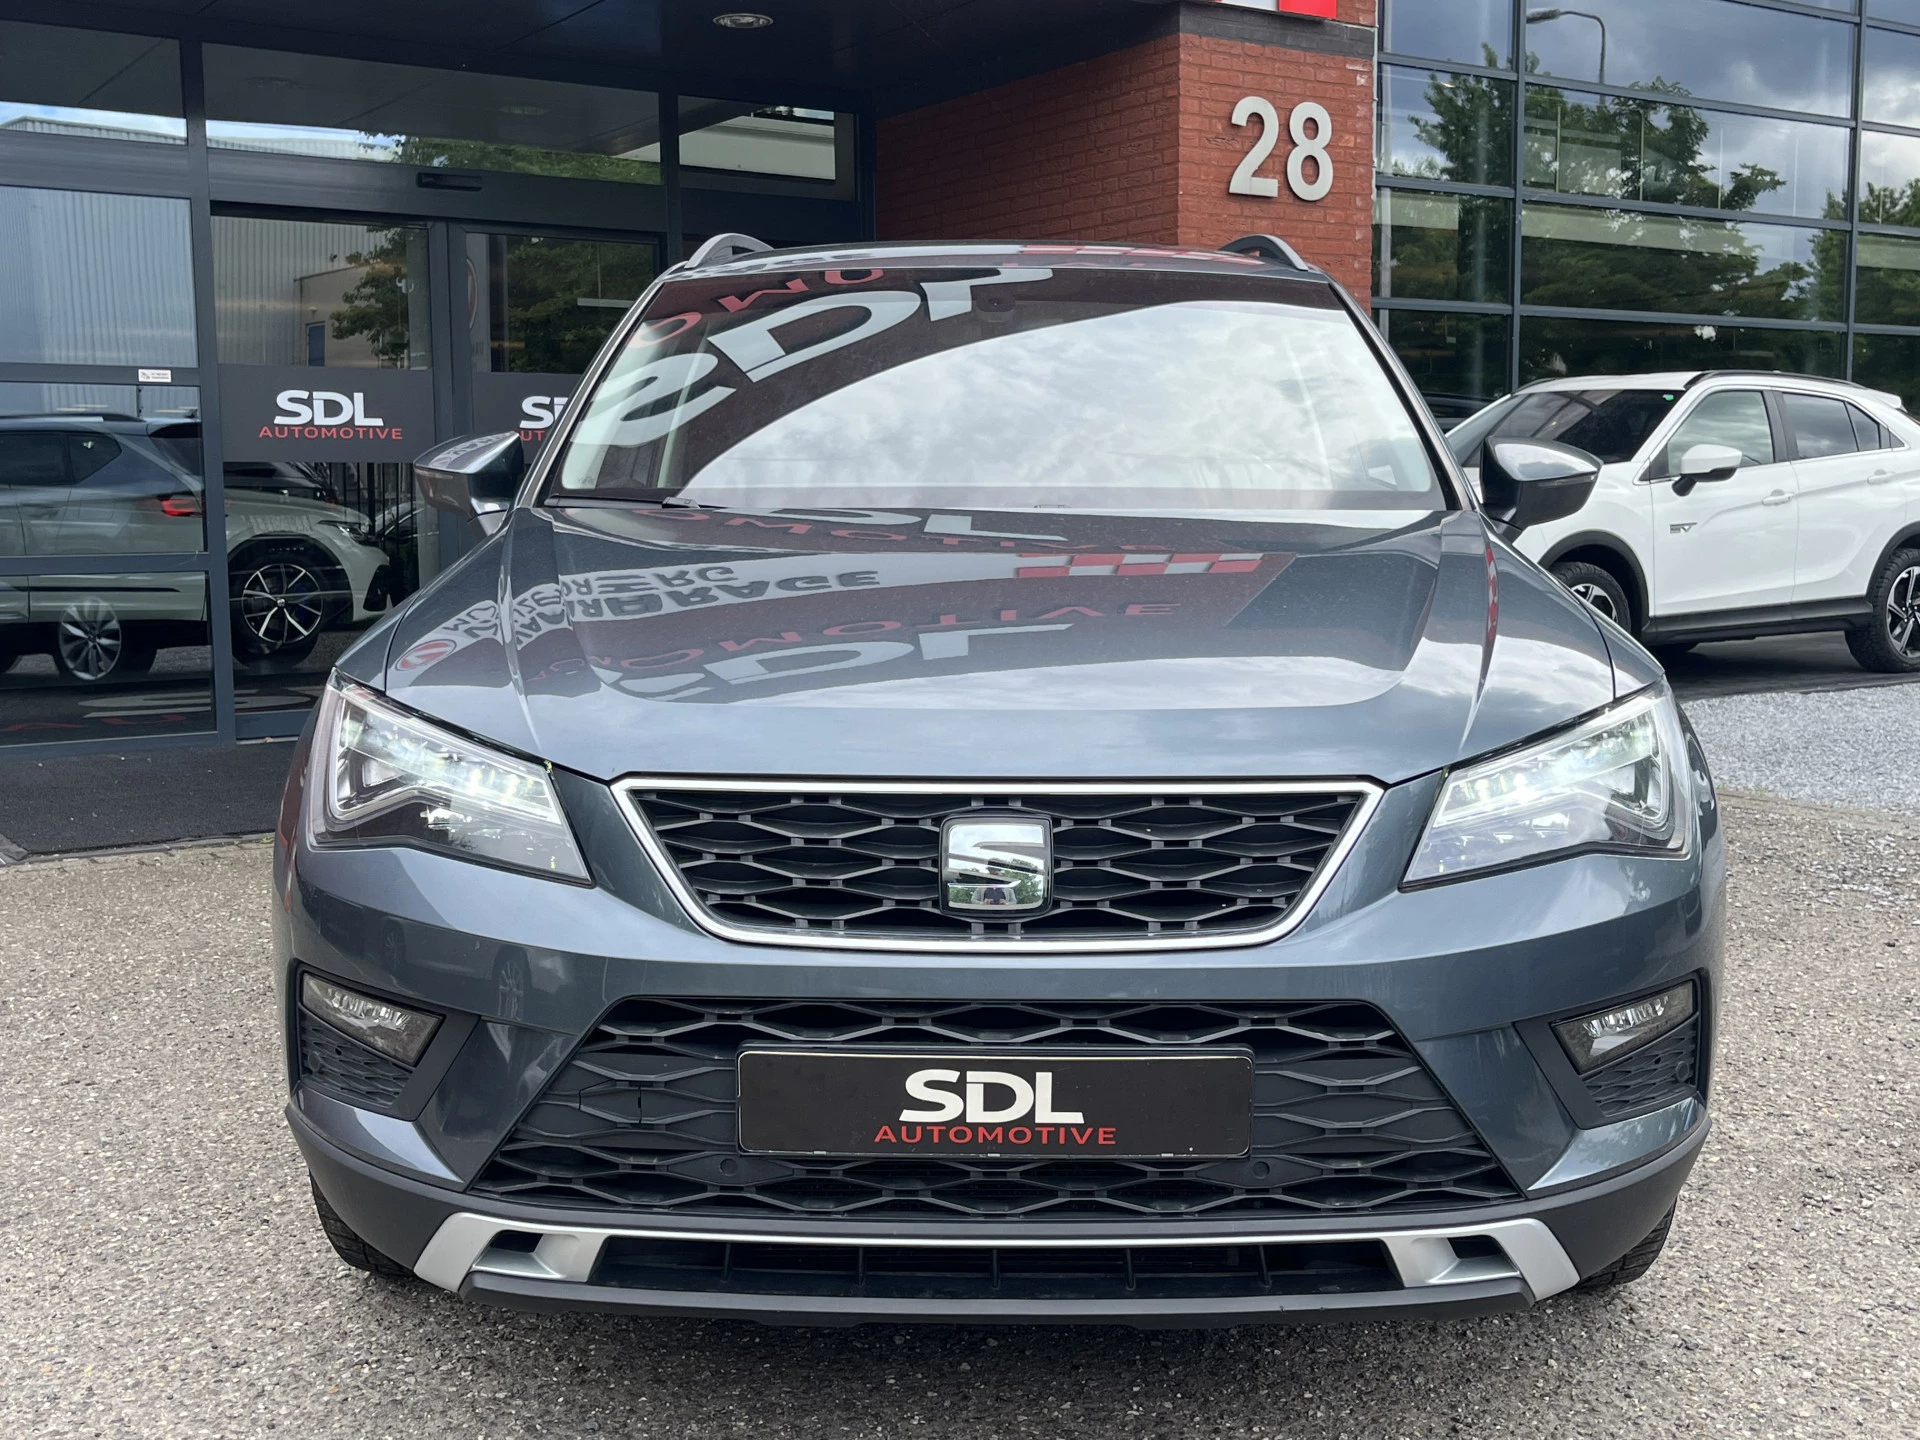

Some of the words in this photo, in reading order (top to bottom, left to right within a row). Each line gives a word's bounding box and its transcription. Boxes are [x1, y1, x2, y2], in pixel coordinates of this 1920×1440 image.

[1229, 95, 1334, 201] 28
[273, 389, 384, 426] SDL
[258, 425, 403, 440] AUTOMOTIVE
[898, 1068, 1085, 1124] SDL
[873, 1125, 1117, 1145] AUTOMOTIVE
